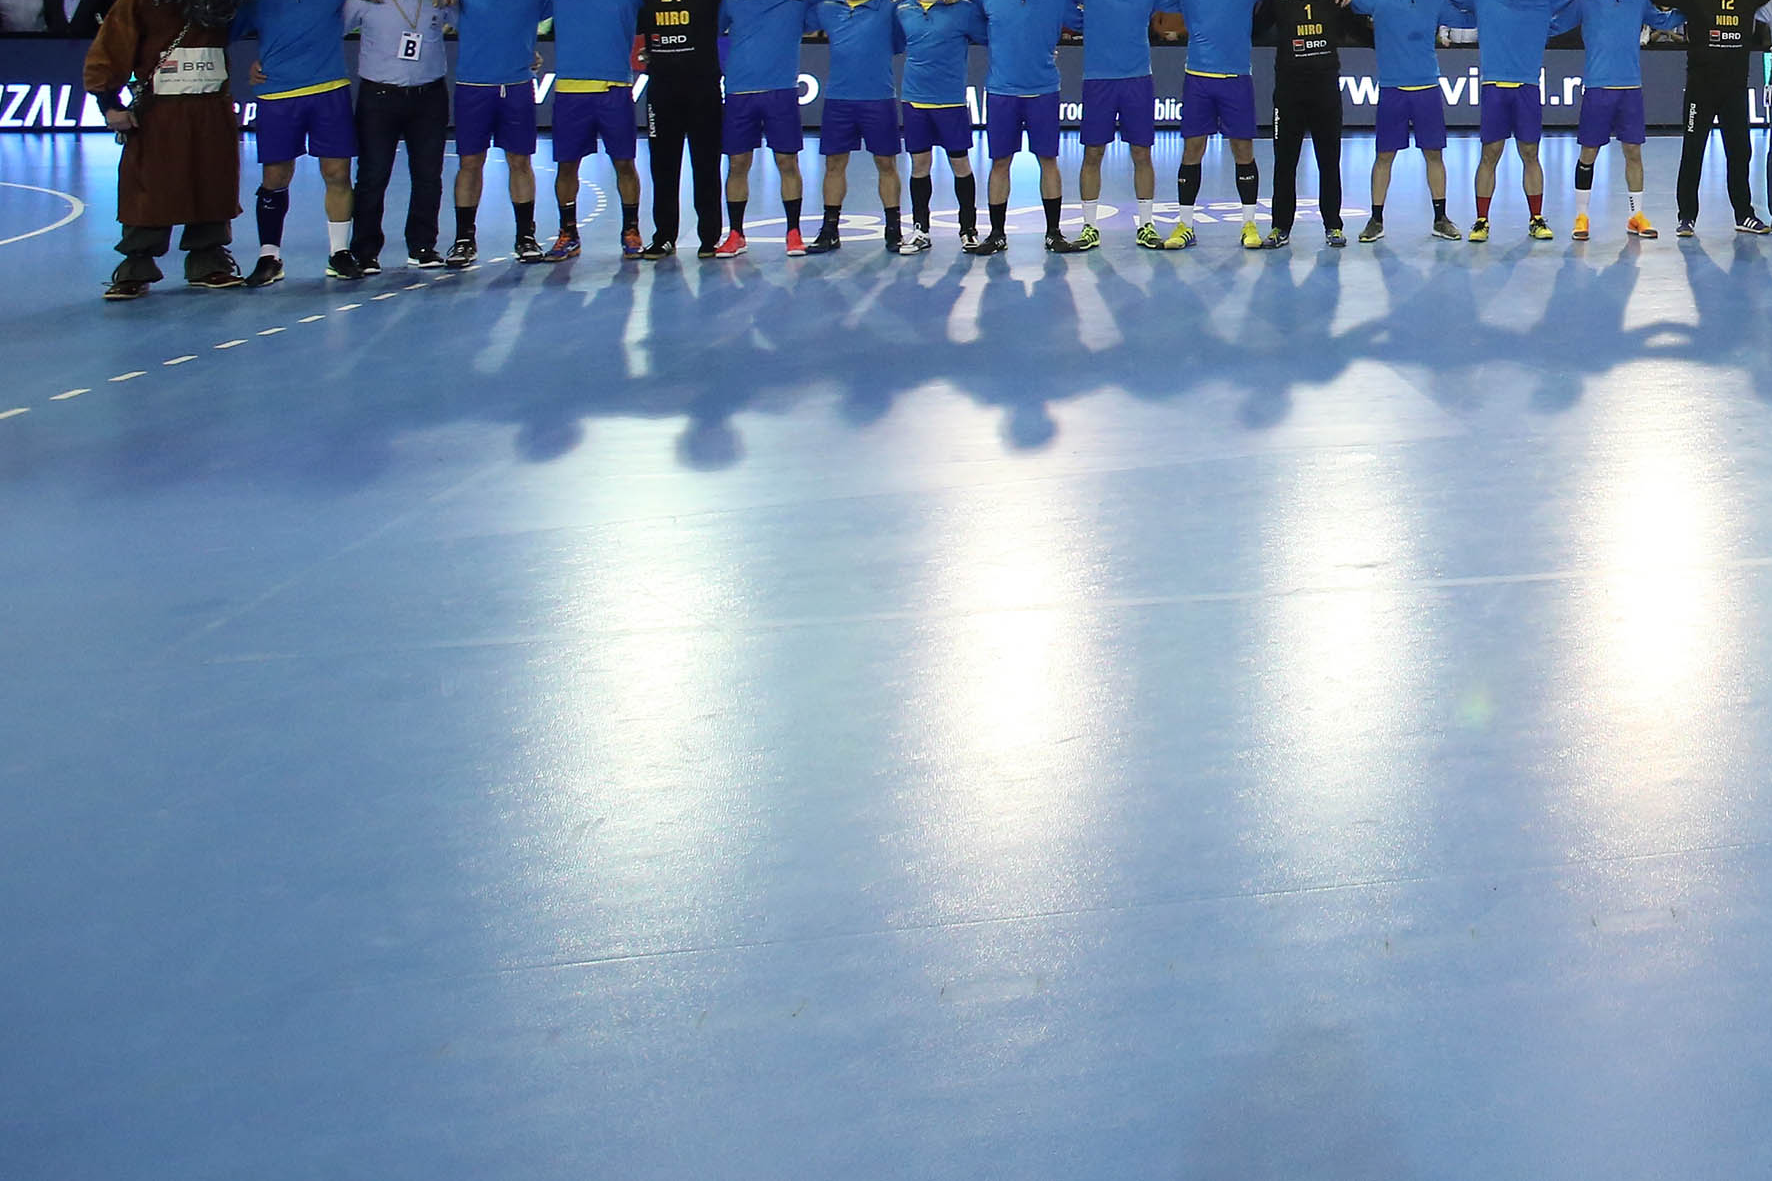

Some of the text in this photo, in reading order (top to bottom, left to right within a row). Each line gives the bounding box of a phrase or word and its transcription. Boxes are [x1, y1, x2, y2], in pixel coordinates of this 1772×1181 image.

[656, 10, 690, 26] NIRO
[1304, 3, 1312, 20] 1
[1716, 14, 1739, 26] NIRO
[1297, 23, 1323, 36] NIRO
[1721, 32, 1741, 41] BRD
[661, 35, 687, 44] BRD
[1306, 39, 1327, 50] BRD
[403, 39, 417, 58] B
[0, 84, 77, 127] ZAL
[1687, 102, 1697, 133] Kempa
